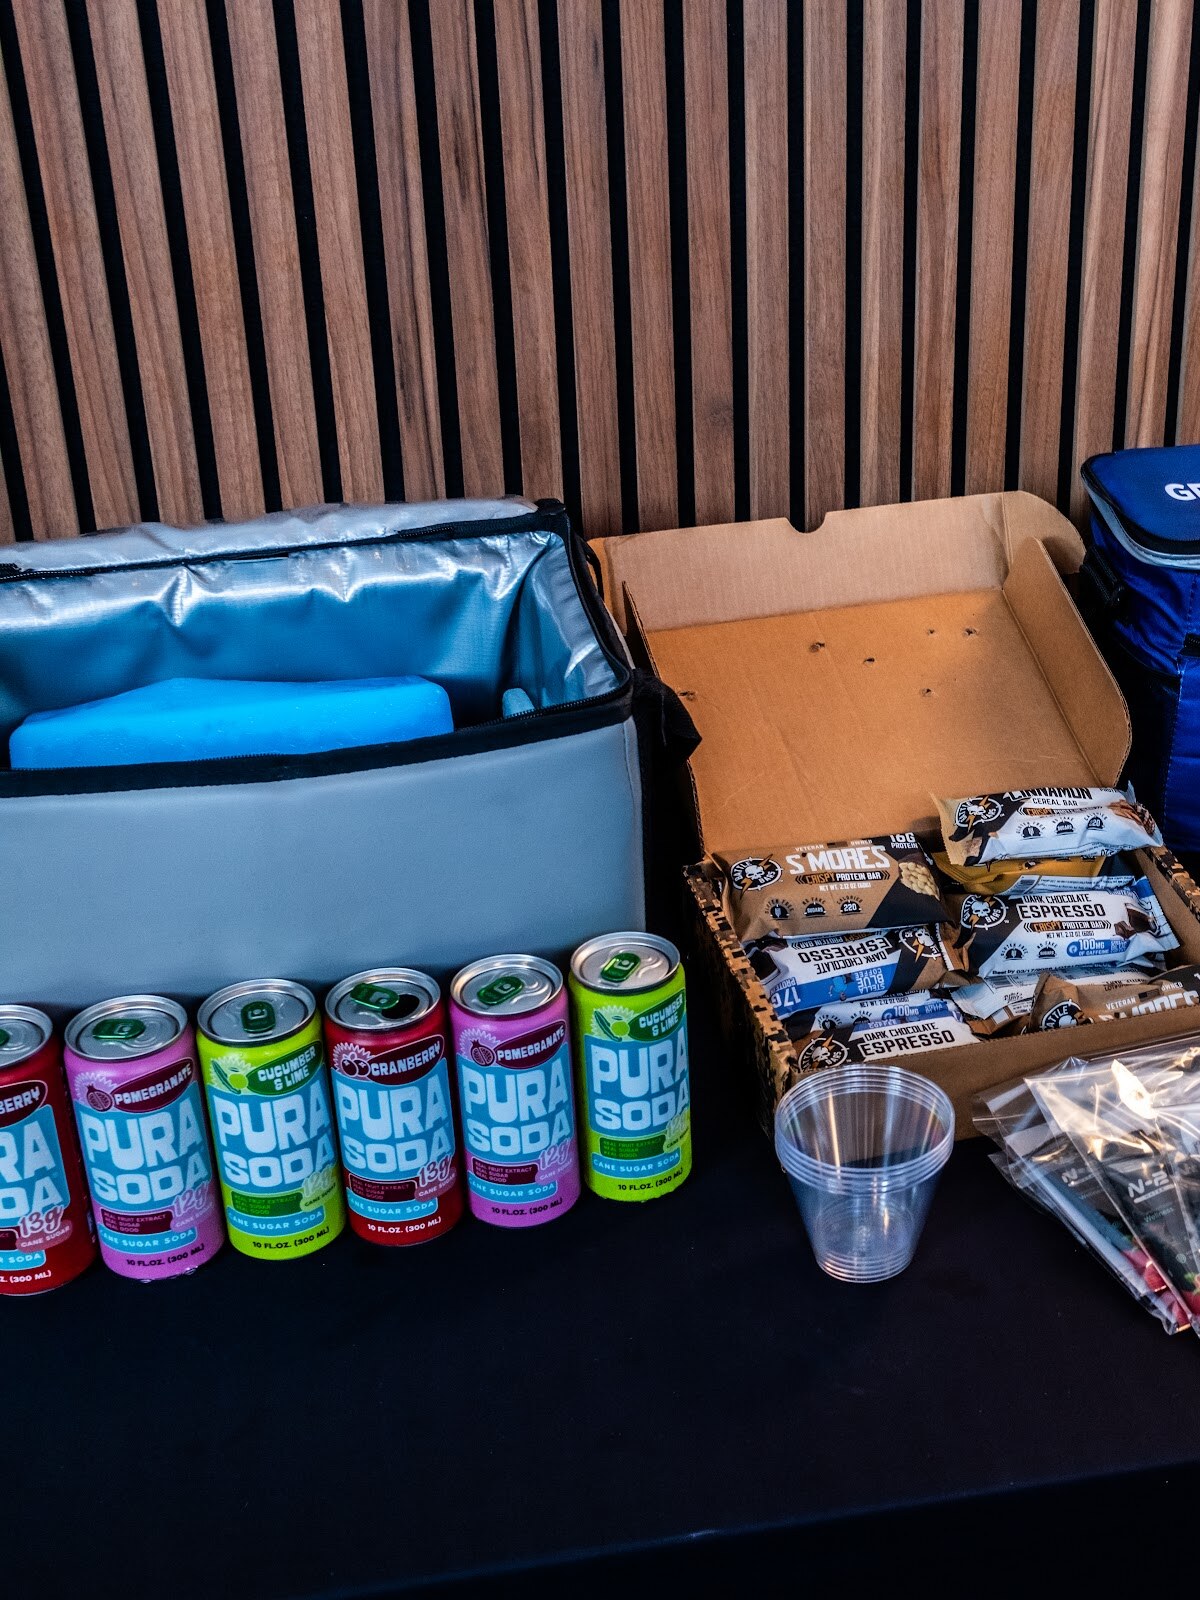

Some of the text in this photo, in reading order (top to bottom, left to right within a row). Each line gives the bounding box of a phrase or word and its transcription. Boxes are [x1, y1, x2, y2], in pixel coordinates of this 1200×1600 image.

[1032, 797, 1061, 806] CEREAL
[795, 844, 824, 852] VETERAN
[890, 833, 916, 843] 16G
[806, 872, 881, 885] CRISPY PROTEIN BAR
[843, 903, 857, 911] 220
[1023, 894, 1092, 904] DARK CHOCOLATE
[985, 908, 1002, 923] BARS
[1021, 904, 1107, 919] ESPRESSO
[1033, 920, 1104, 932] CRISPY PROTEIN BAR
[798, 938, 890, 963] ESPRESSO
[799, 936, 844, 948] PROTEIN BAR
[1086, 948, 1109, 956] CAFFEINE
[816, 950, 887, 975] DARK CHOCOLATE
[854, 968, 882, 978] COFFEE
[857, 974, 885, 986] BLUE
[770, 987, 801, 1007] 17G
[859, 983, 885, 993] STELLA
[1105, 997, 1136, 1011] VETERAN
[1161, 982, 1183, 992] OWNED
[639, 995, 683, 1028] CUCUMBER
[661, 1014, 678, 1034] LIME
[864, 1022, 938, 1041] DARK CHOCOLATE
[498, 1027, 565, 1060] POMEGRANATE
[861, 1030, 955, 1056] ESPRESSO
[257, 1046, 317, 1082] CUCUMBER
[371, 1041, 441, 1076] CRANBERRY
[591, 1026, 688, 1098] PURA
[114, 1063, 192, 1106] POMEGRANATE
[275, 1069, 310, 1091] & LIME
[462, 1057, 570, 1123] PURA
[336, 1080, 448, 1141] PURA
[594, 1079, 690, 1131] SODA
[213, 1080, 331, 1154] PURA
[80, 1099, 204, 1170] PURA
[467, 1111, 570, 1155] SODA
[223, 1128, 336, 1187] SODA
[344, 1127, 452, 1173] SODA
[418, 1154, 452, 1188] 13g
[593, 1159, 655, 1173] CANE SUGAR
[91, 1151, 210, 1205] SODA
[489, 1183, 555, 1197] SUGAR SODA
[367, 1200, 435, 1214] SUGAR SODA
[252, 1211, 323, 1230] SUGAR SODA
[405, 1223, 425, 1232] (300
[427, 1216, 442, 1227] ML)
[20, 1226, 70, 1248] CANE SUGAR
[122, 1229, 194, 1247] SUGAR SODA
[253, 1241, 263, 1249] 10
[294, 1233, 315, 1247] (300
[316, 1227, 330, 1239] ML)
[8, 1254, 42, 1263] SODA
[190, 1244, 204, 1256] ML)
